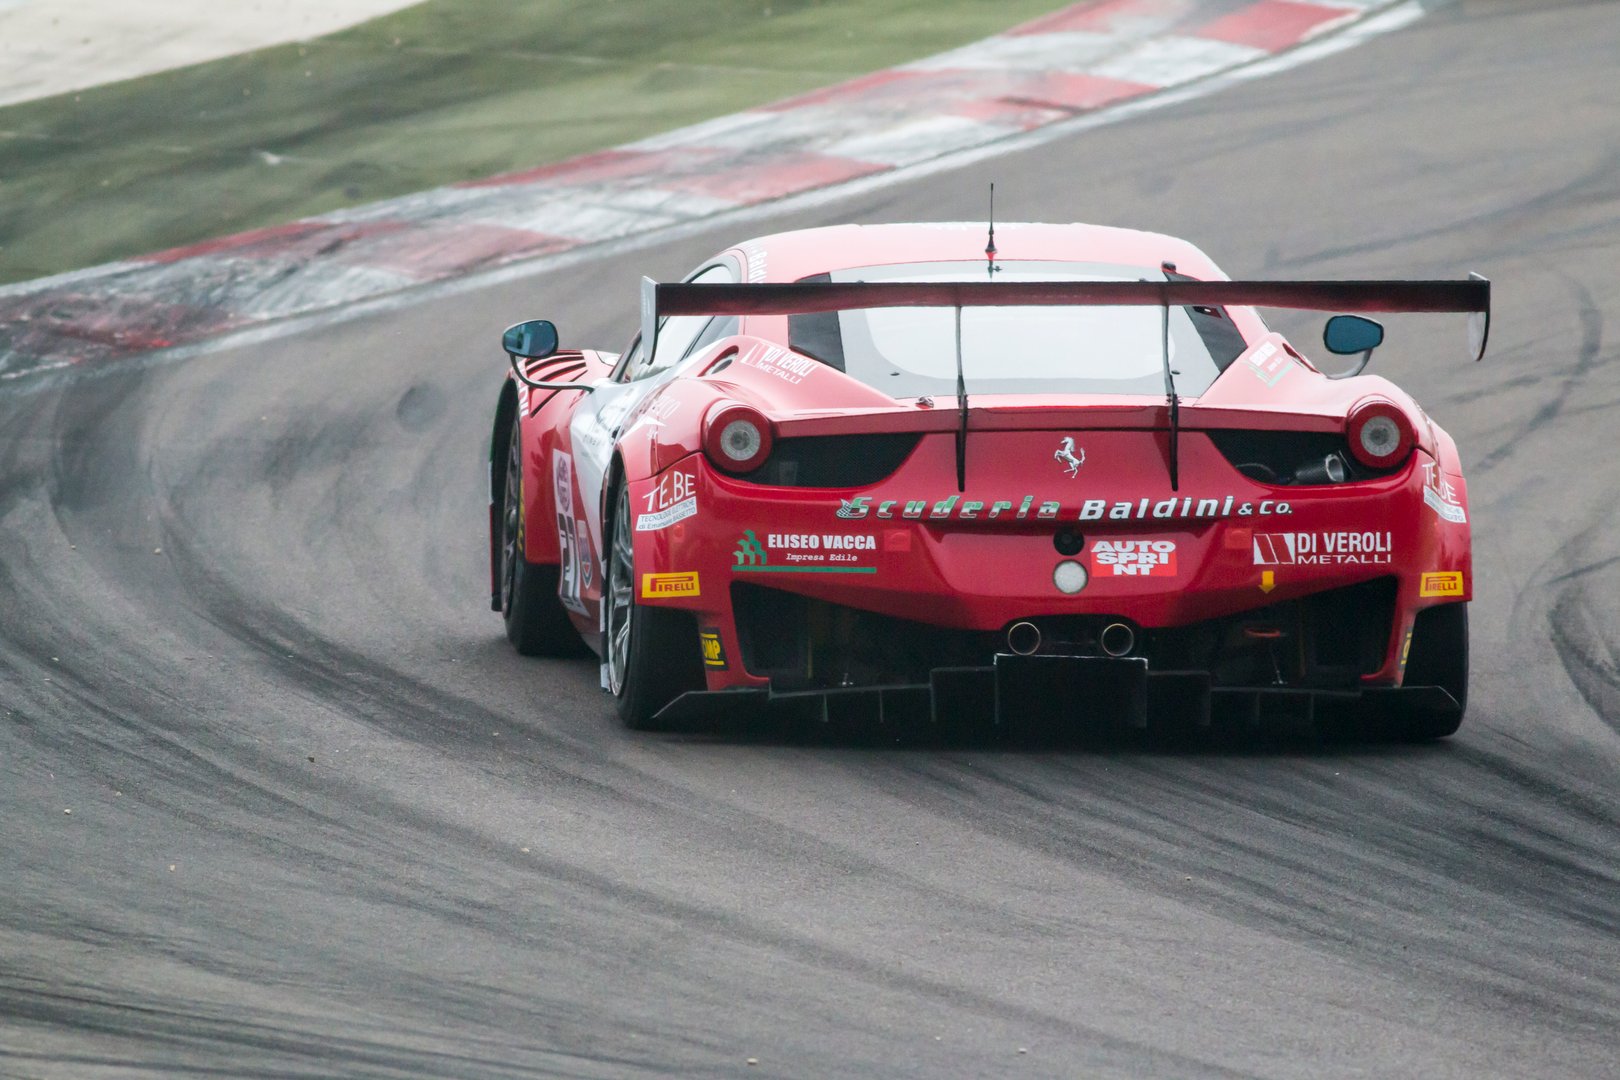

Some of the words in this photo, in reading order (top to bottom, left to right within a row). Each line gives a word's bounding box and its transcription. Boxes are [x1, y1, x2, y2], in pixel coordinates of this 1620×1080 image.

[777, 352, 818, 377] VEROLI
[757, 363, 802, 385] METALLI
[843, 495, 1061, 519] Scuderia
[1079, 496, 1234, 520] Baldini
[1238, 503, 1253, 515] &
[768, 534, 820, 549] ELISEO
[823, 534, 876, 549] VACCA
[1091, 540, 1175, 552] AUTO
[1297, 533, 1317, 552] DI
[1323, 532, 1392, 552] VEROLI
[786, 552, 825, 562] Impresa
[829, 552, 858, 562] Edile
[1096, 552, 1169, 564] SPRI
[1297, 554, 1392, 564] METALLI
[1113, 564, 1154, 576] NT
[650, 576, 694, 592] PIRELLI
[1425, 575, 1457, 592] PIRELLI
